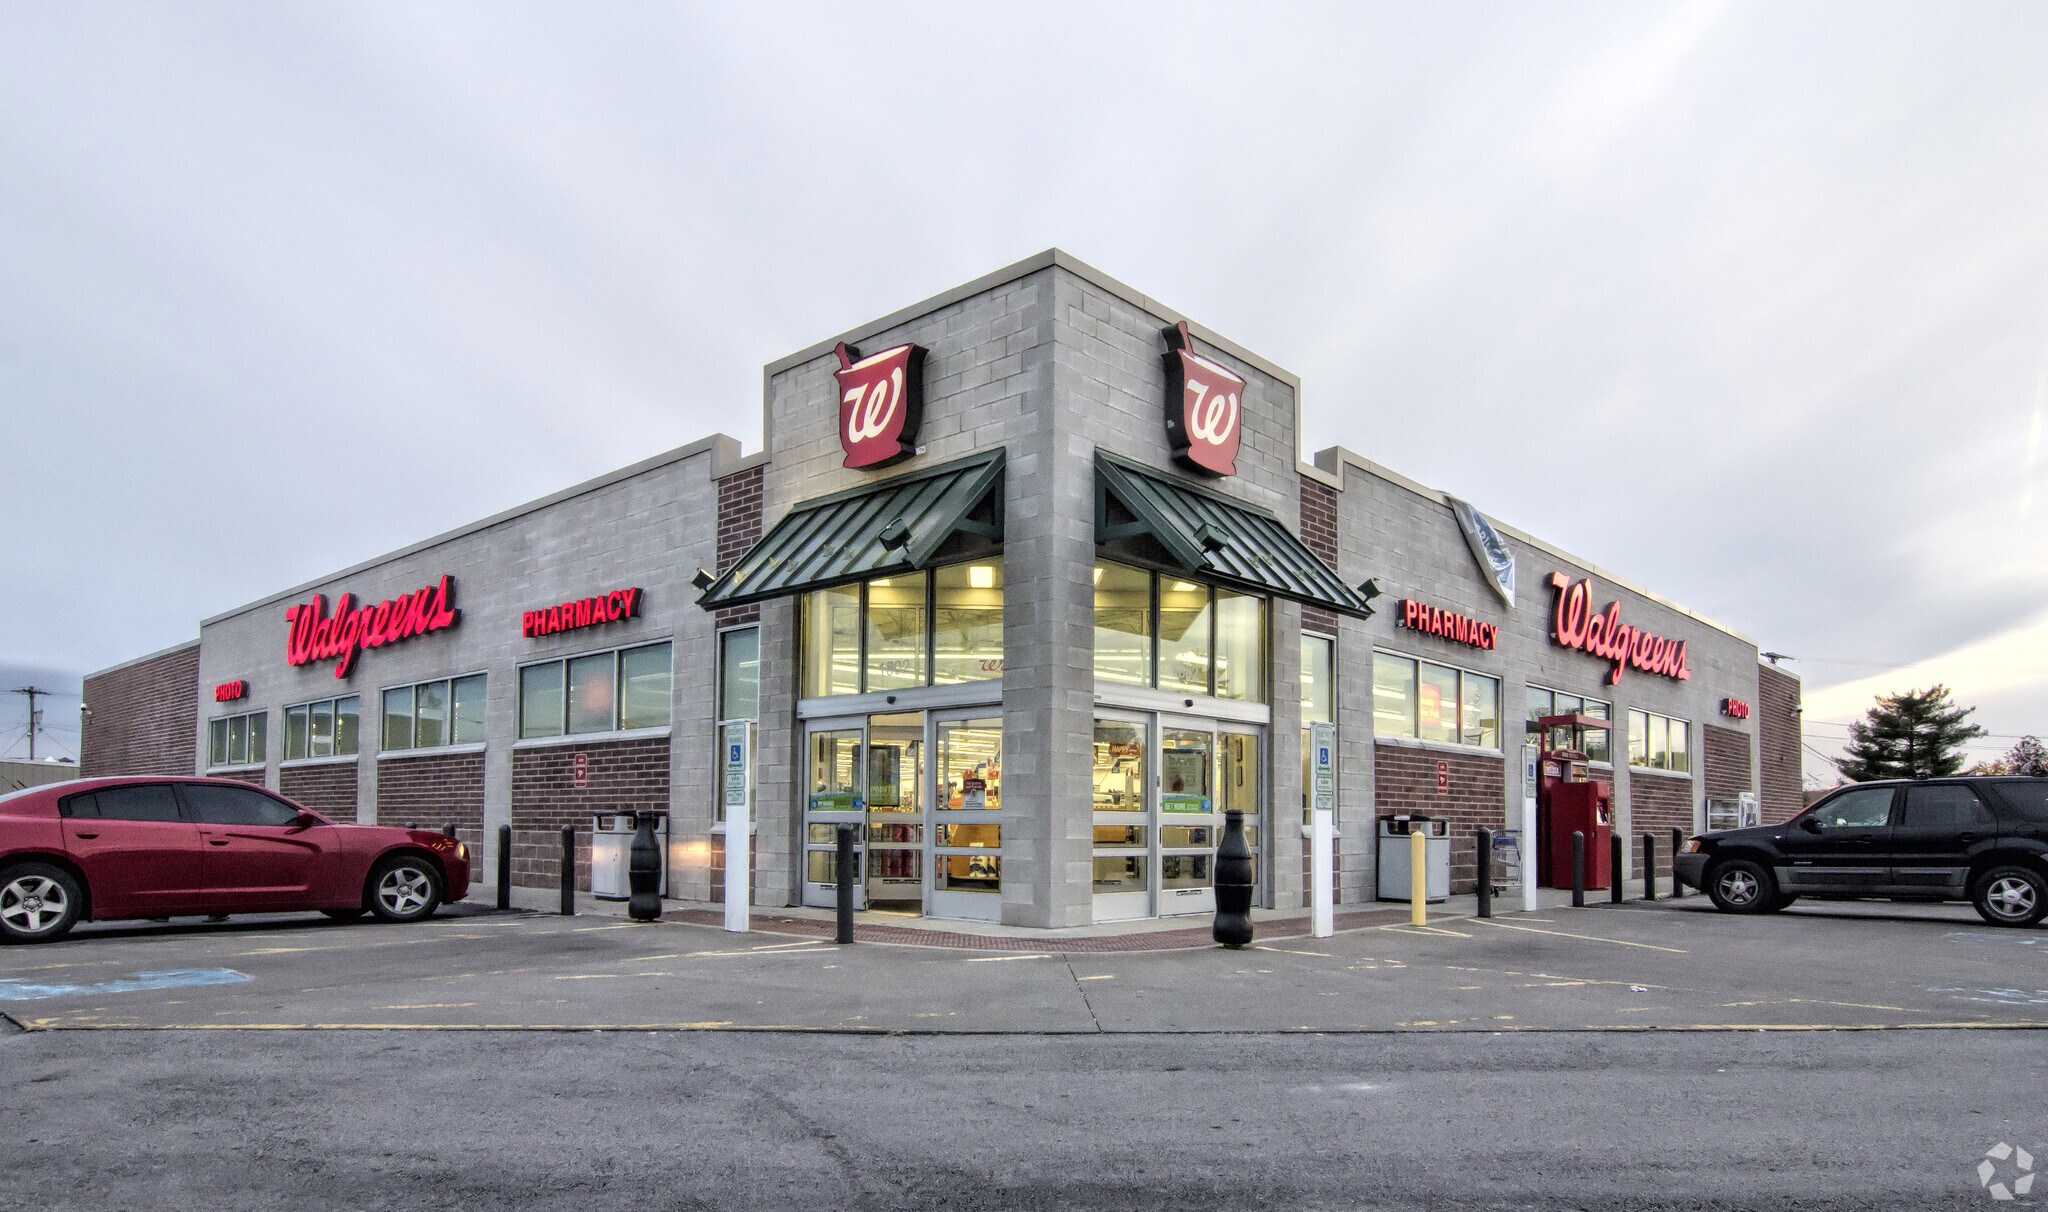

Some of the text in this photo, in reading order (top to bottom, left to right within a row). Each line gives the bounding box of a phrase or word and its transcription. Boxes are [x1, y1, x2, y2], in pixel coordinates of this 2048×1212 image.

[843, 366, 903, 444] W
[1186, 378, 1238, 446] W
[286, 575, 455, 679] Walgreens
[523, 587, 637, 638] PHARMACY
[1405, 598, 1498, 650] PHARMACY
[1552, 571, 1690, 686] Walgreens
[214, 680, 242, 702] PHOTO
[1728, 697, 1750, 719] PHOTO
